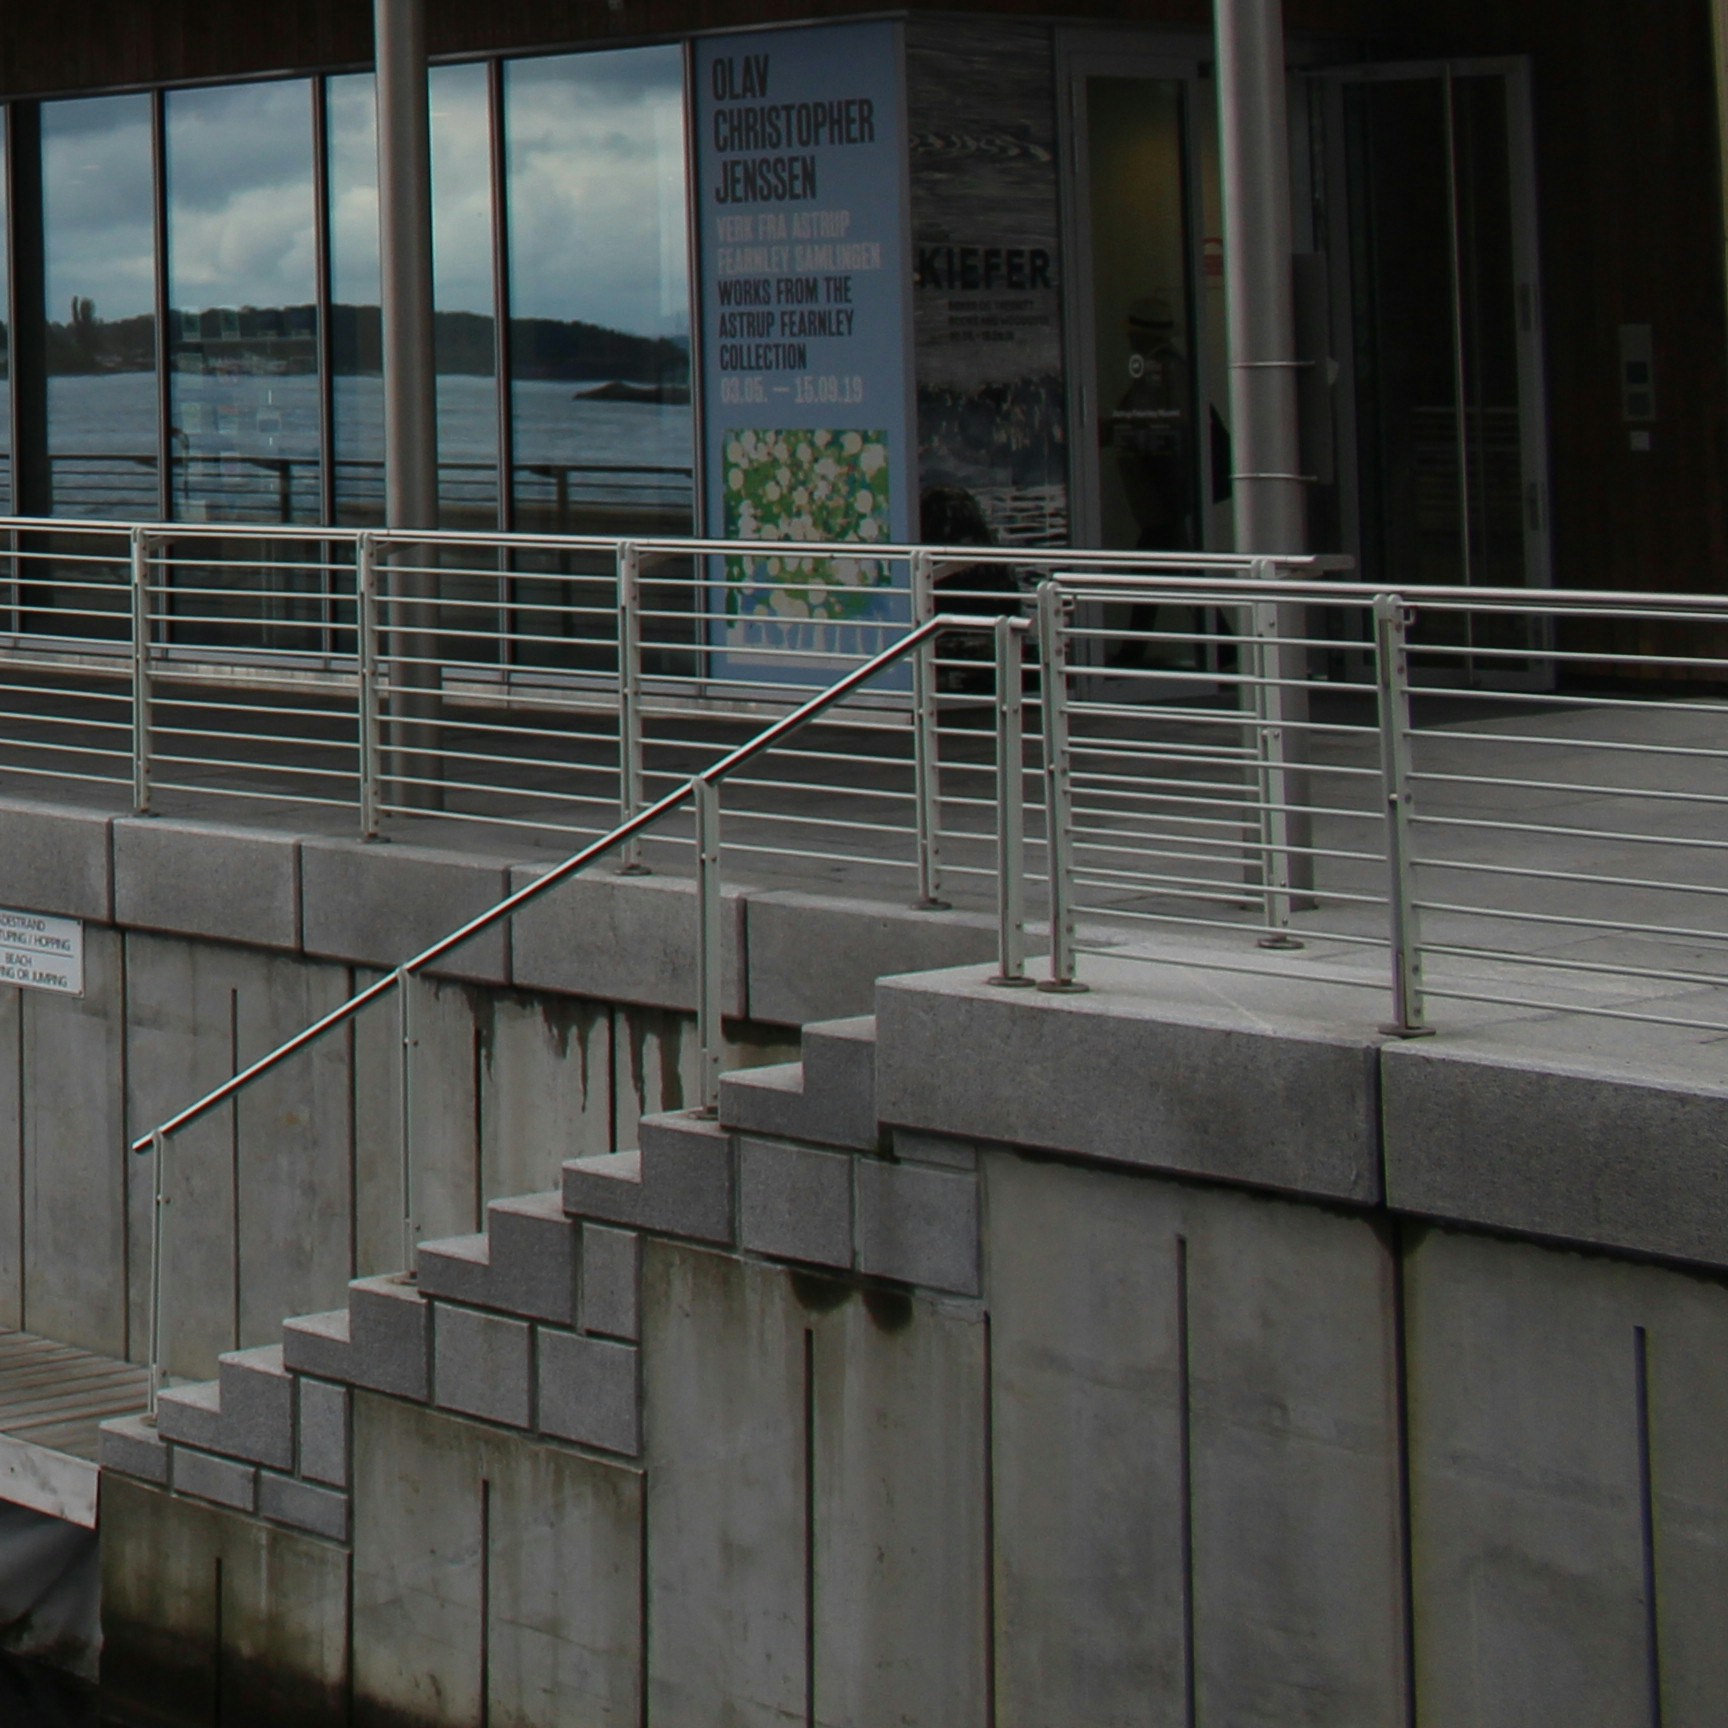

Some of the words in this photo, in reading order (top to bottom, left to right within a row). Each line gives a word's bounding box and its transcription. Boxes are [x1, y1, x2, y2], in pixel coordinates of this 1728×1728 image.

[712, 54, 770, 101] OLAV
[713, 98, 875, 153] CHRISTOPHER
[715, 155, 817, 204] JENSSEN
[716, 214, 754, 243] VERK
[758, 213, 787, 241] FRA
[792, 209, 851, 240] ASTRUP
[717, 245, 789, 275] FEARNLEY
[794, 242, 881, 273] SAMLINGEN
[918, 247, 1052, 290] KIEFER
[717, 278, 771, 306] WORKS
[776, 276, 819, 306] FROM
[823, 275, 853, 304] THE
[718, 311, 775, 339] ASTRUP
[780, 308, 854, 337] FEARNLEY
[719, 342, 807, 371] COLLECTION
[794, 374, 865, 404] 15.09.19
[34, 934, 71, 951] HOPPING
[5, 952, 33, 967] BEACH
[17, 968, 30, 980] OR
[31, 970, 68, 988] JUMPING
